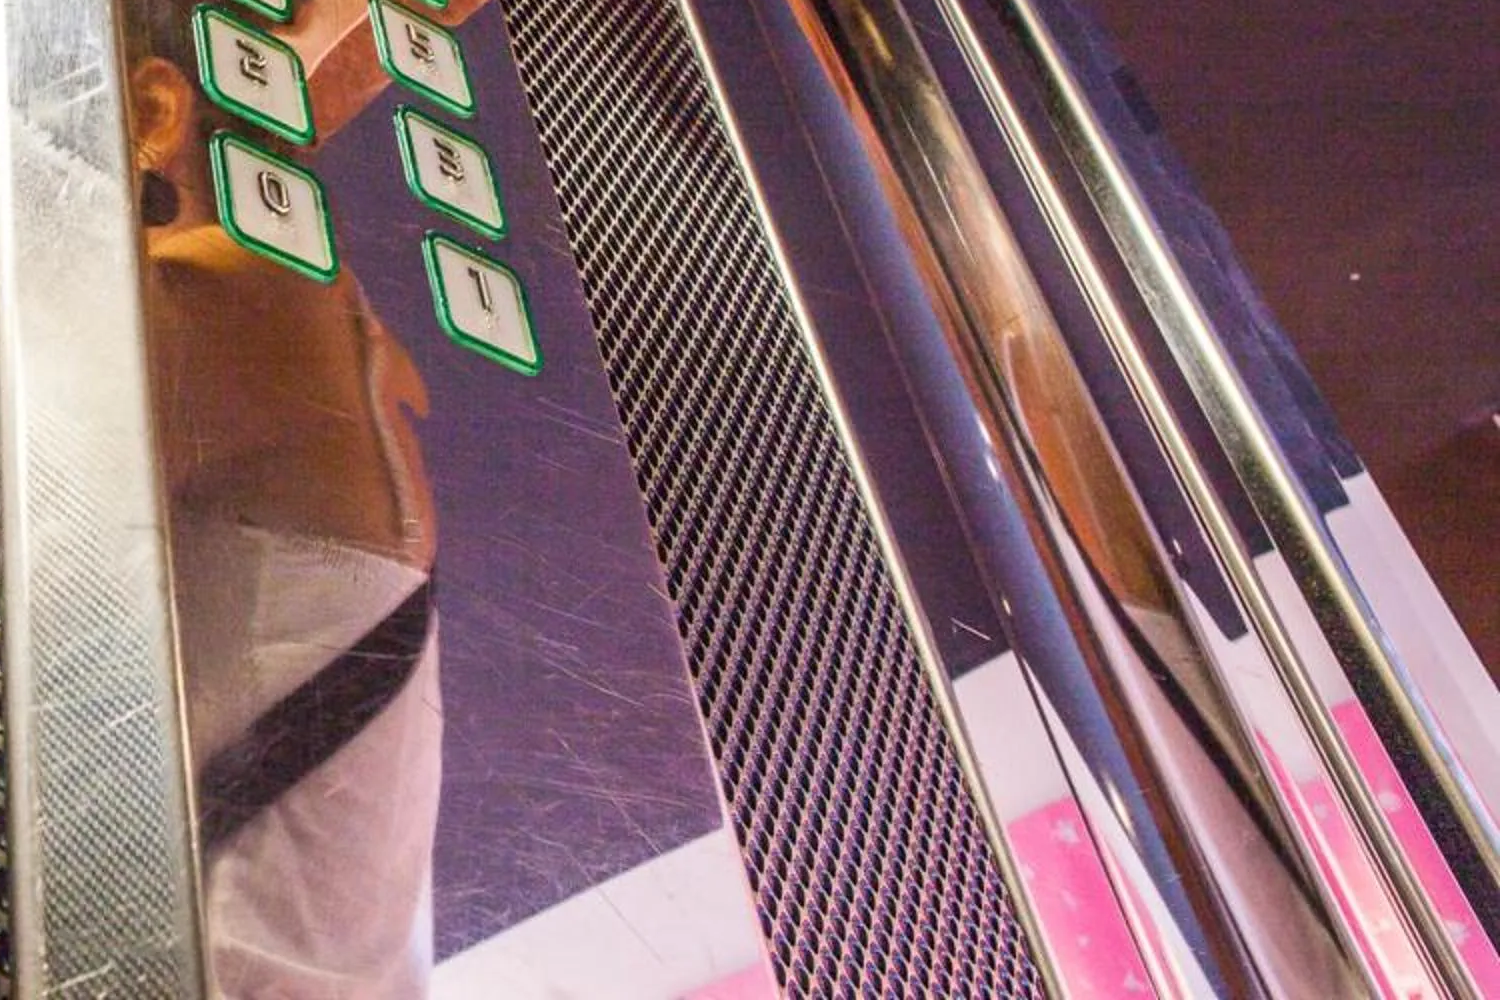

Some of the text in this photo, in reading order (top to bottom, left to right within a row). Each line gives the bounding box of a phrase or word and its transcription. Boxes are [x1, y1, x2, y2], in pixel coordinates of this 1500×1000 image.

[236, 38, 268, 86] 2
[405, 23, 435, 63] 5
[433, 137, 465, 182] 3
[258, 171, 291, 217] 0
[467, 266, 493, 313] 1
